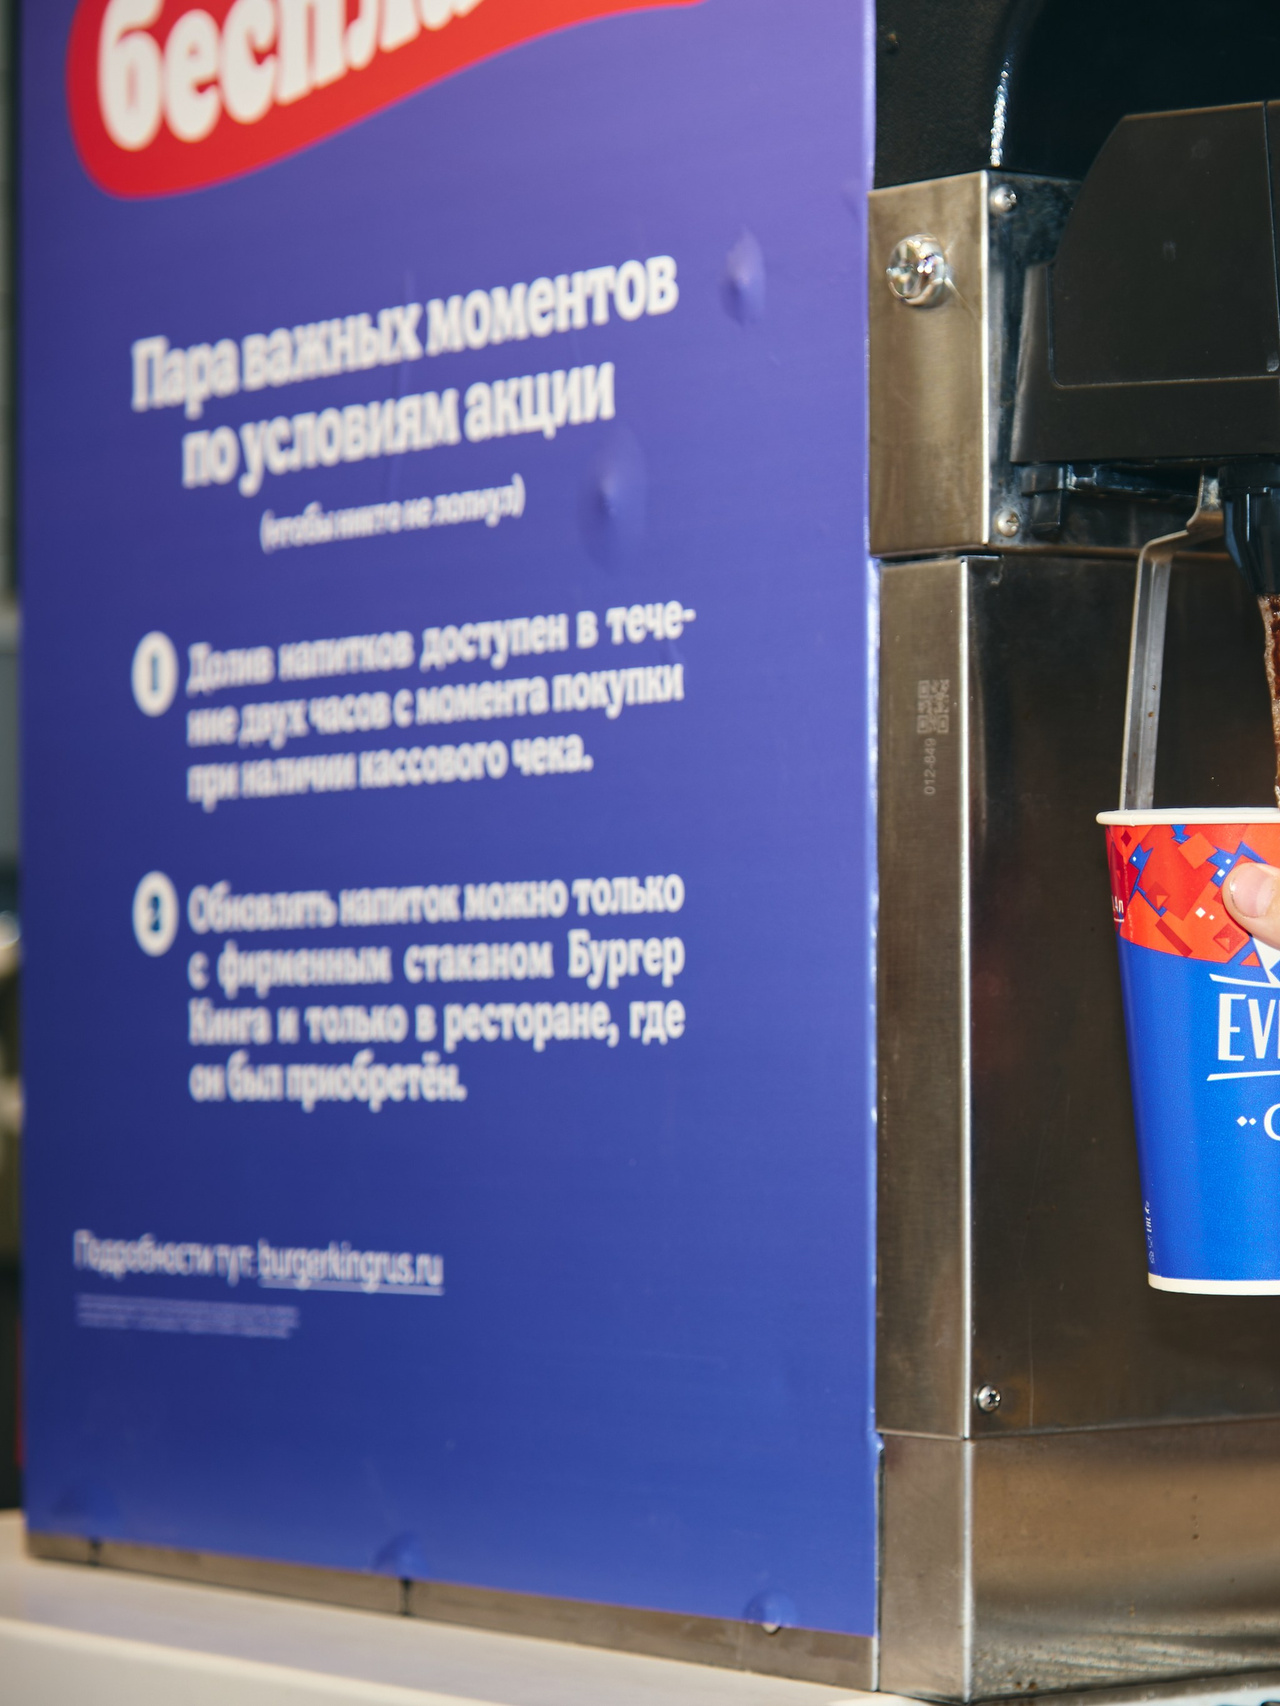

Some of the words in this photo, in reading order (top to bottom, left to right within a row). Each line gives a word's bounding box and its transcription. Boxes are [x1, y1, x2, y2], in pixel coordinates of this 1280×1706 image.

[97, 0, 487, 152] беспл
[131, 334, 239, 420] Пара
[243, 301, 423, 391] важных
[426, 255, 680, 356] моментов
[182, 425, 239, 489] по
[239, 387, 462, 497] условиям
[464, 361, 616, 441] акции
[260, 502, 336, 554] (чтобы
[337, 503, 401, 540] никто
[404, 496, 431, 530] не
[431, 472, 526, 528] лопнул)
[186, 642, 275, 697] Долив
[278, 630, 414, 682] напитков
[419, 613, 569, 671] доступен
[575, 609, 599, 648] в
[606, 599, 696, 645] тече-
[187, 706, 238, 747] ние
[238, 699, 308, 750] двух
[310, 693, 392, 735] часов
[393, 688, 413, 728] с
[415, 676, 550, 725] момента
[552, 663, 684, 719] покупки
[187, 763, 239, 813] при
[241, 752, 357, 800] наличии
[358, 740, 509, 789] кассового
[511, 733, 593, 778] чека.
[187, 880, 338, 934] Обновлять
[339, 883, 461, 928] напиток
[462, 879, 569, 921] можно
[571, 873, 685, 915] только
[187, 950, 210, 991] с
[216, 940, 393, 1000] фирменным
[403, 941, 554, 983] стаканом
[567, 928, 686, 989] Бургер
[187, 996, 274, 1046] Кинга
[276, 1005, 301, 1045] и
[304, 1003, 409, 1044] только
[415, 1003, 437, 1043] в
[443, 1001, 620, 1053] ресторане,
[628, 999, 686, 1046] где
[188, 1063, 227, 1101] он
[226, 1049, 284, 1101] был
[285, 1049, 468, 1113] приобретён.
[73, 1229, 212, 1281] Подробности
[259, 1238, 444, 1294] burgerkingrus.ru
